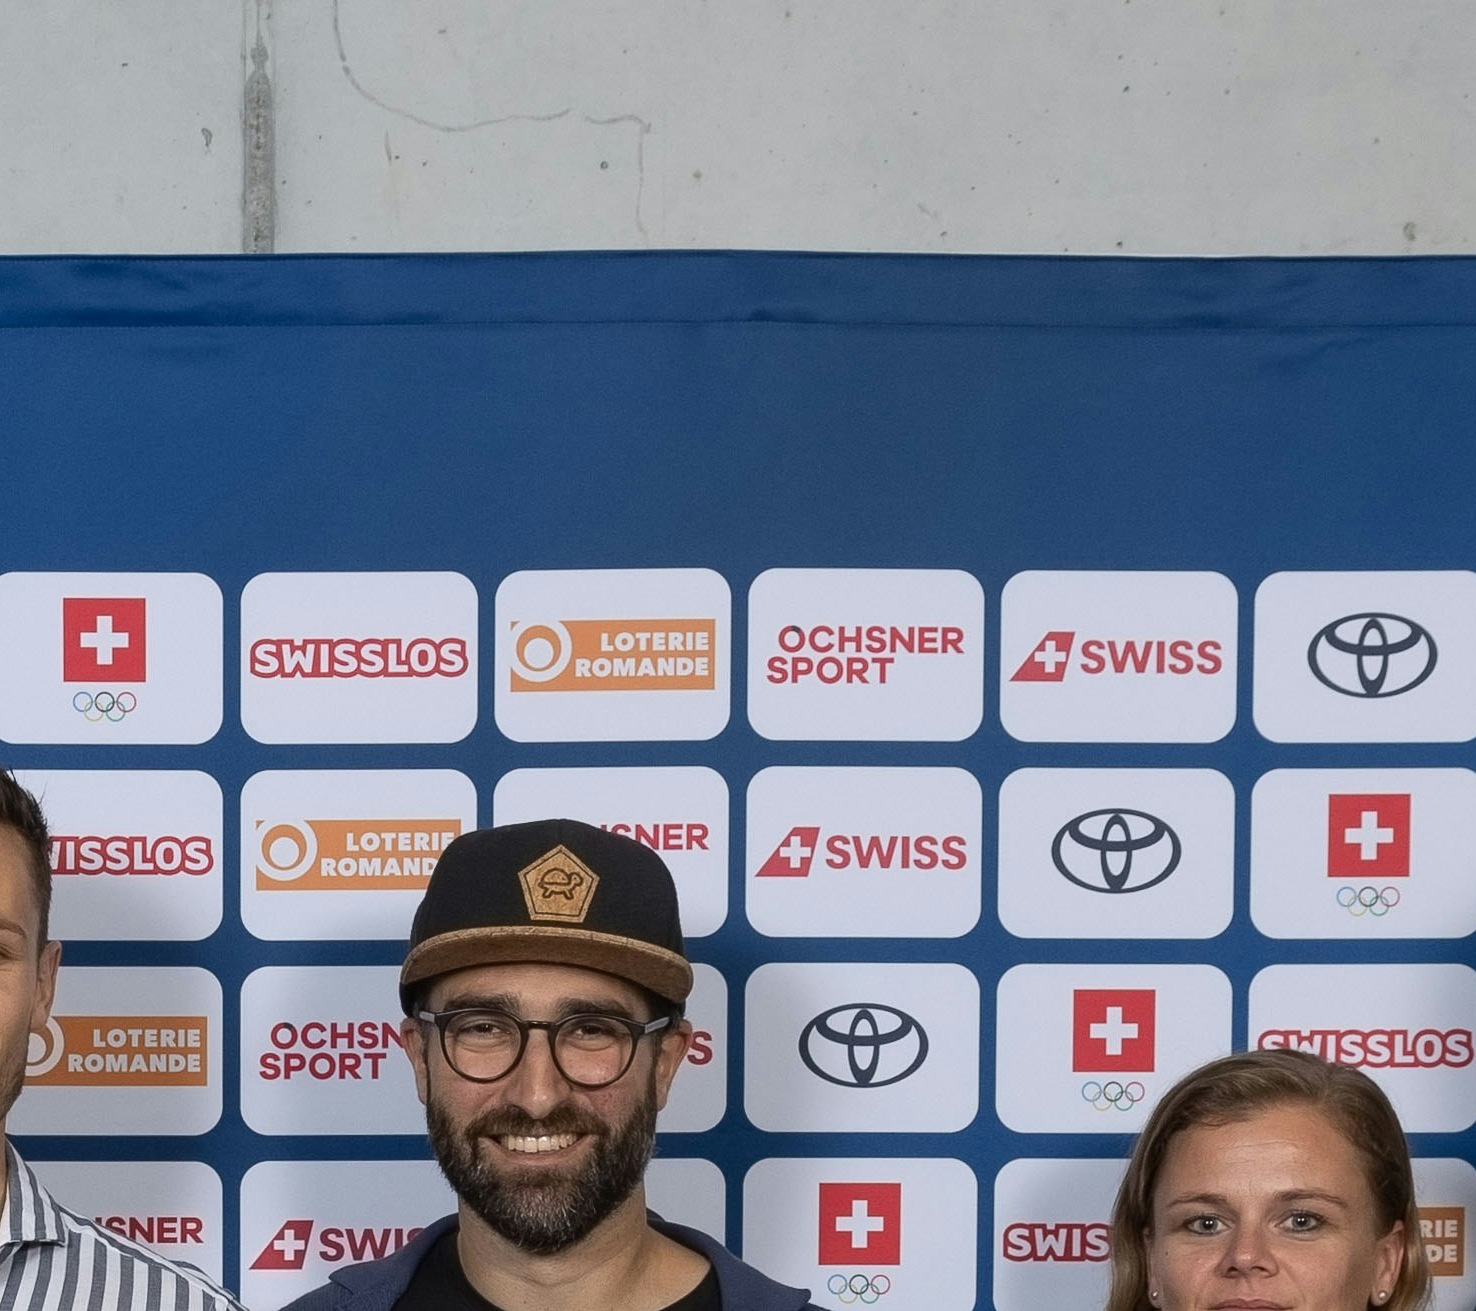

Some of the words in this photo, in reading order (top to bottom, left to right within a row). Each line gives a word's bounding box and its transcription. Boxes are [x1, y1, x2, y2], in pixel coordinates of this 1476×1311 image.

[601, 632, 709, 651] LOTERIE
[778, 625, 964, 653] OCHSNER
[250, 638, 468, 678] SWISSLOS
[576, 657, 708, 677] ROMANDE
[767, 656, 894, 684] SPORT
[1081, 640, 1222, 674] SWISS
[49, 834, 214, 876] ISSLOS
[826, 835, 966, 870] SWISS
[321, 858, 435, 877] ROMAND
[94, 1029, 200, 1047] LOTERIE
[271, 1022, 405, 1049] OCHSN
[68, 1054, 200, 1072] ROMANDE
[260, 1052, 387, 1080] SPORT
[1003, 1223, 1112, 1262] SWIS
